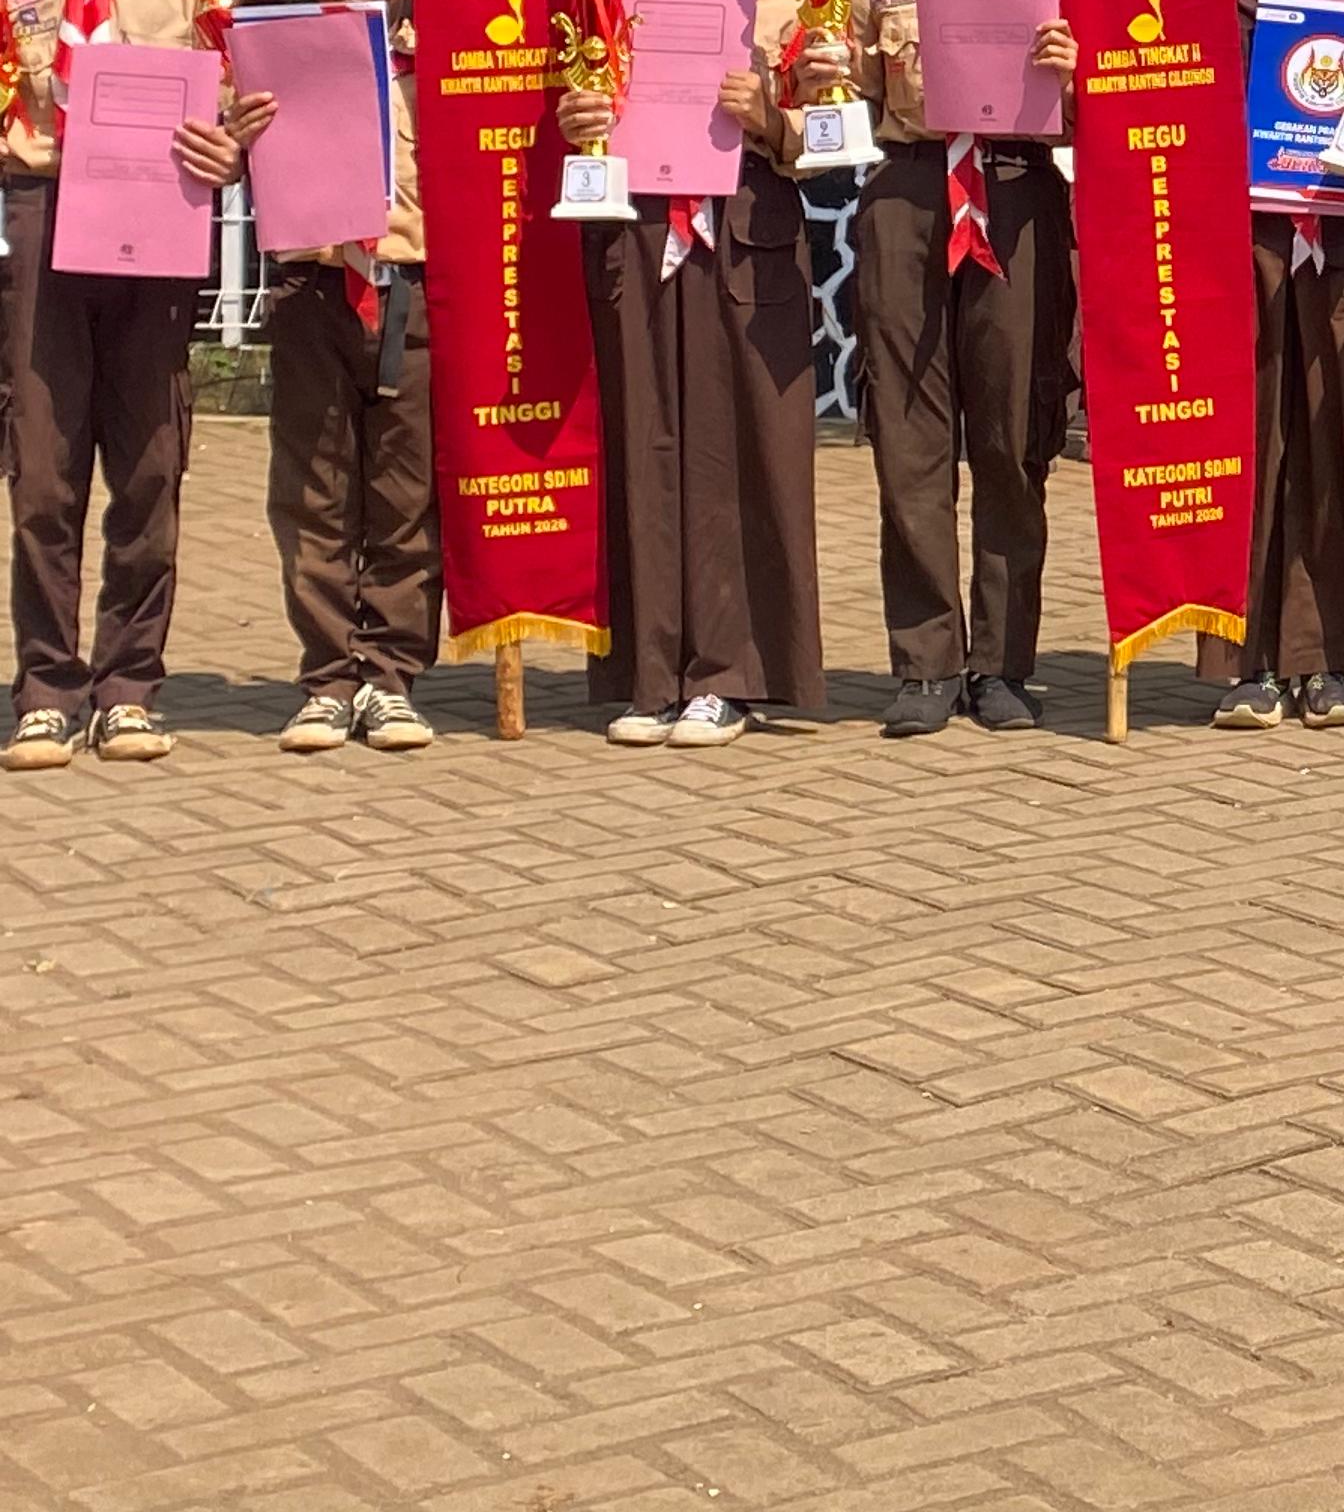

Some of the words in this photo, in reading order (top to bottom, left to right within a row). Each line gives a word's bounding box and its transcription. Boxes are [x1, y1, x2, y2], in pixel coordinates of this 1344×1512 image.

[452, 50, 494, 71] LOMBA
[496, 47, 548, 69] TINGKAT
[1096, 48, 1138, 70] LOMBA
[1138, 44, 1190, 67] TINGKAT
[1192, 43, 1201, 63] II
[479, 125, 537, 151] REGU
[819, 120, 830, 138] 2
[1127, 124, 1187, 151] REGU
[501, 157, 524, 395] BERPRESTASI
[1150, 155, 1181, 393] BERPRESTASI
[473, 400, 561, 427] TINGGI
[1135, 397, 1215, 425] TINGGI
[458, 471, 540, 496] KATEGORI
[543, 467, 590, 489] SD/MI
[1123, 461, 1201, 488] KATEGORI
[1204, 455, 1242, 479] SD/MI
[486, 495, 556, 517] PUTRA
[1160, 485, 1213, 509] PUTRI
[482, 521, 532, 538] TAHUN
[534, 517, 569, 533] 2026
[1150, 509, 1194, 529] TAHUN
[1195, 506, 1224, 524] 2026
